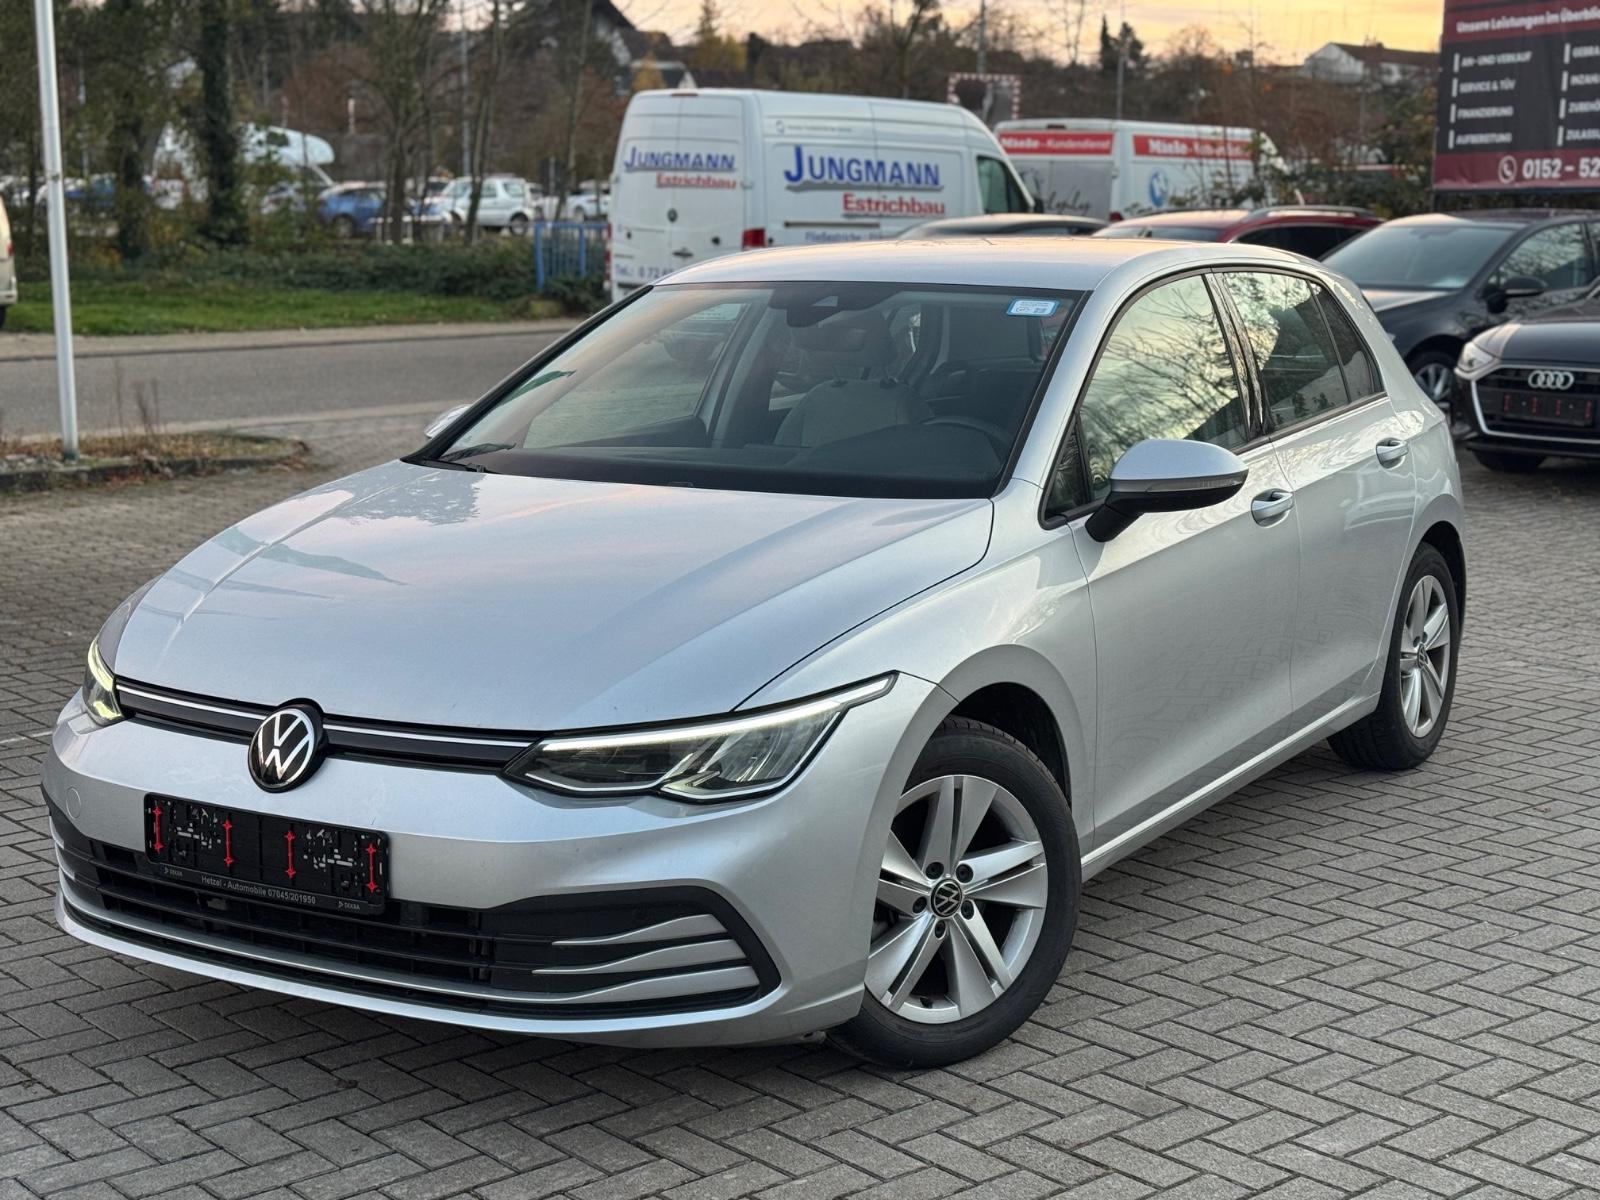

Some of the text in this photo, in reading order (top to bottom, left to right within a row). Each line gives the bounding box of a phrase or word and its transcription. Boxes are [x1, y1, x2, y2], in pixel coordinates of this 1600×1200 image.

[1456, 21, 1489, 33] Unsere
[1491, 15, 1544, 30] Leistungen
[1546, 11, 1559, 23] im
[624, 146, 735, 170] JUNGMANN
[783, 144, 940, 186] JUNGMANN
[1522, 157, 1562, 180] 0152
[1578, 156, 1600, 179] 52
[656, 172, 737, 189] Estrichbau
[843, 193, 945, 215] Estrichbau
[201, 875, 222, 887] Hetzel
[227, 881, 267, 896] Automobile
